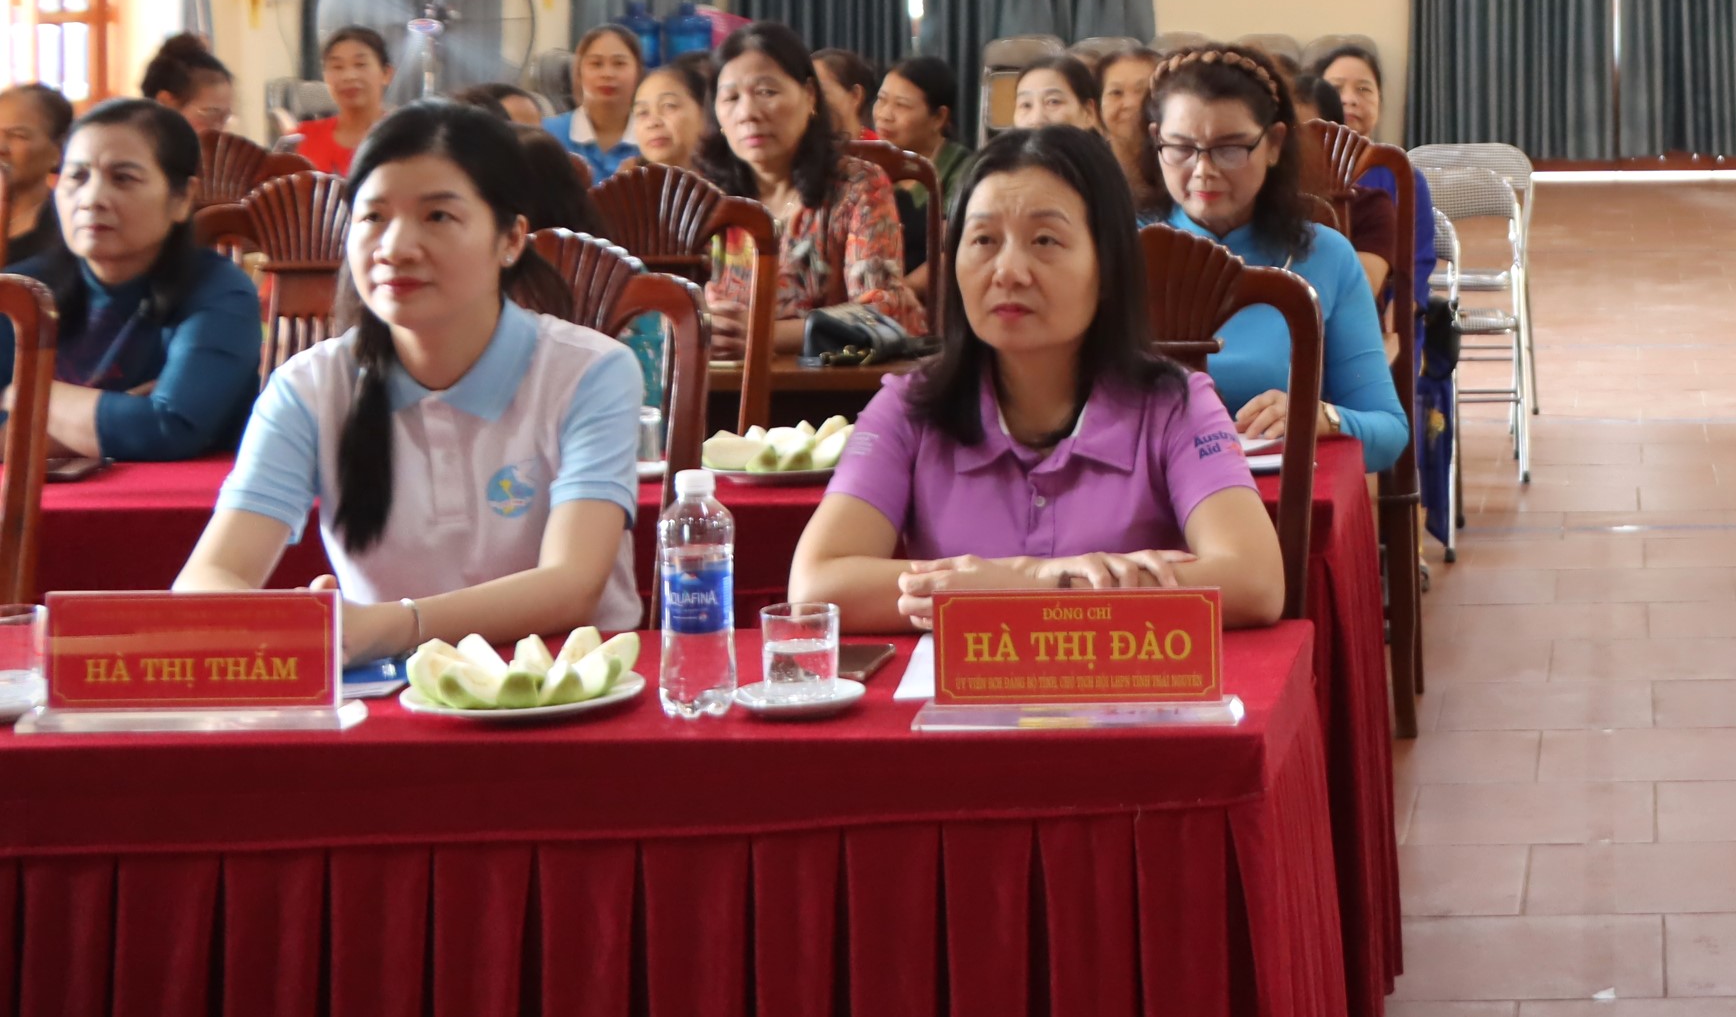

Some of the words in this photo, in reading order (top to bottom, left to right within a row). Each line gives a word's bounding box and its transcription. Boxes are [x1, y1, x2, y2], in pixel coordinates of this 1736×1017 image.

[1199, 442, 1222, 459] Aid
[667, 590, 719, 607] QUAFINA
[1043, 601, 1083, 621] ĐỒNG
[1087, 604, 1112, 620] CHÍ
[963, 622, 1020, 662] HÀ
[1030, 630, 1097, 670] THỊ
[1109, 621, 1192, 661] ĐÀO
[85, 651, 131, 682] HÀ
[140, 657, 195, 688] THỊ
